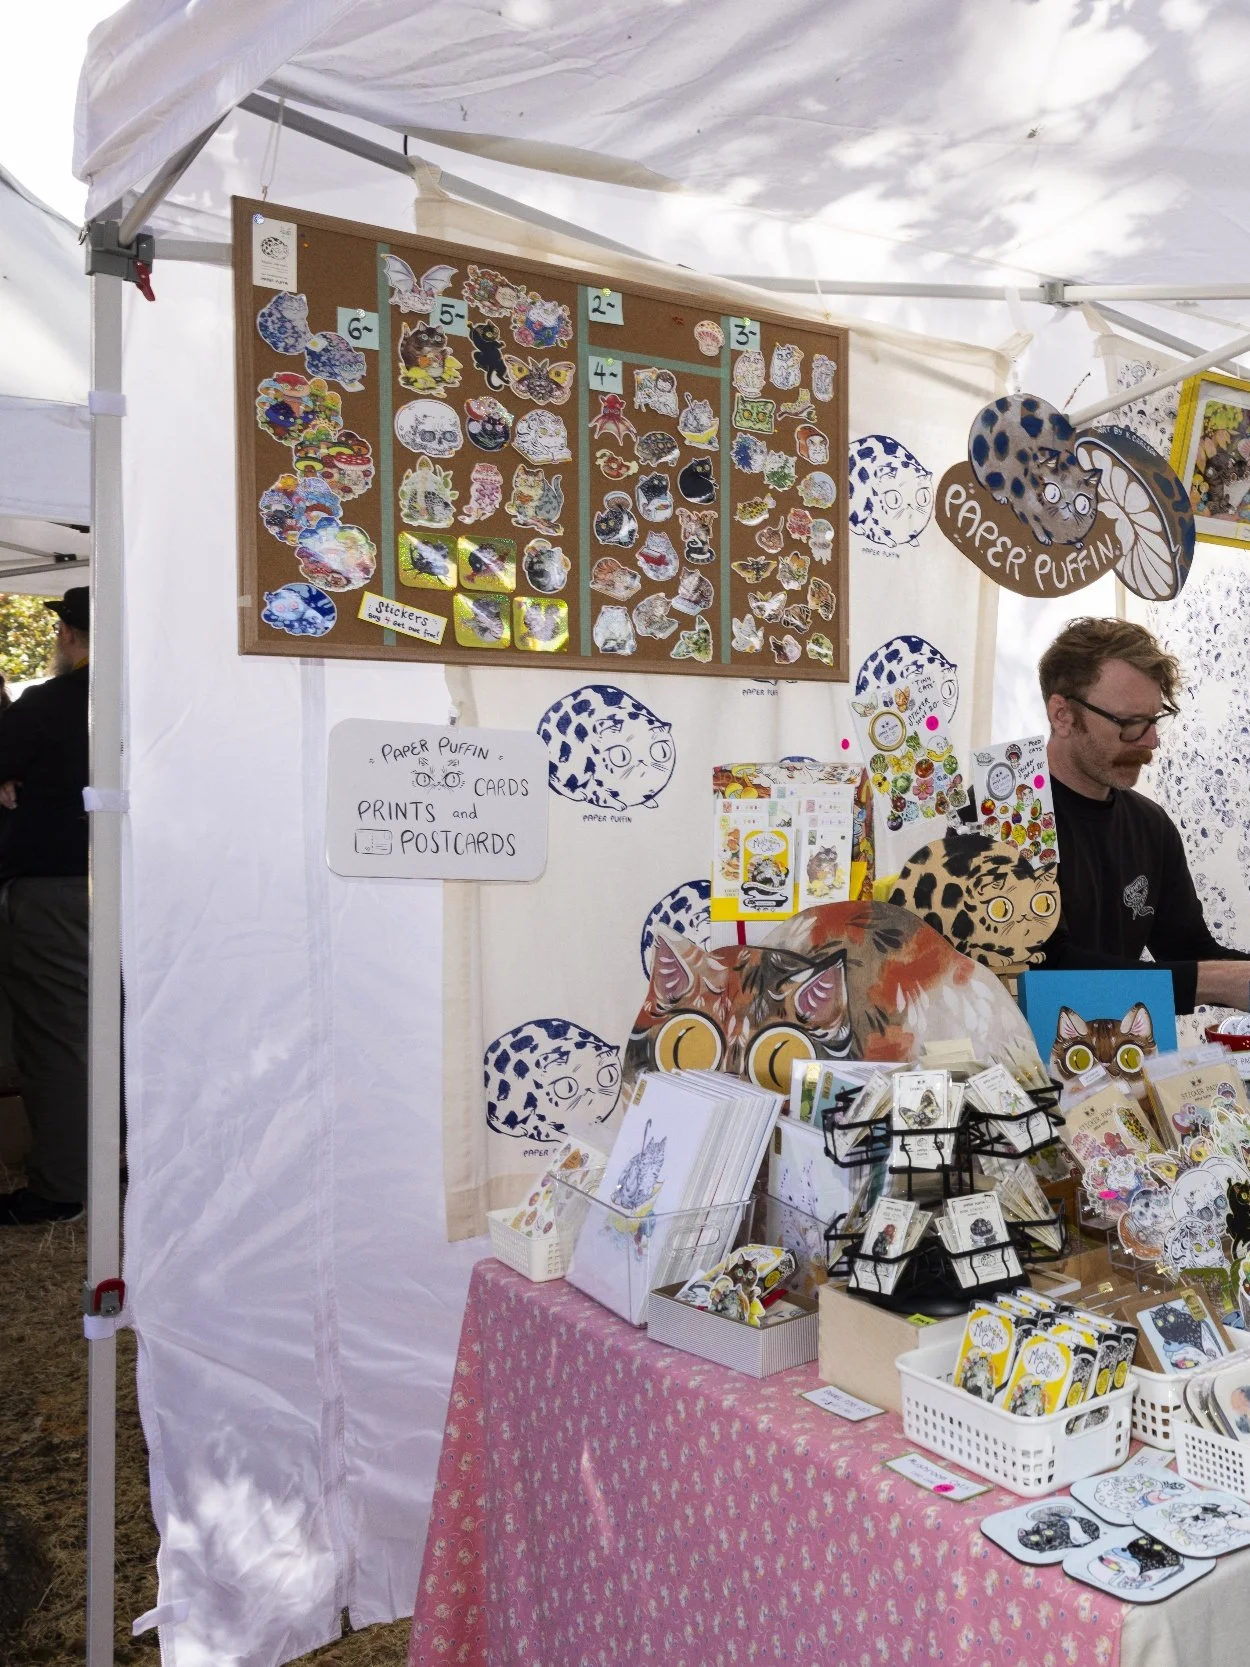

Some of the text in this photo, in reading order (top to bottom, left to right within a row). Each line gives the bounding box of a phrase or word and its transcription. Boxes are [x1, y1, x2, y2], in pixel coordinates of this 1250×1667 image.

[944, 484, 1114, 591] PAPER PUFFIN
[376, 600, 428, 627] Stickers
[742, 688, 764, 696] PAPER
[381, 736, 490, 764] PAPER PUFFIN
[474, 778, 530, 797] CARDS
[357, 800, 478, 822] PRINTS and
[582, 814, 607, 822] PAPER
[400, 830, 517, 856] POSTCARDS
[524, 1150, 548, 1158] PAPER
